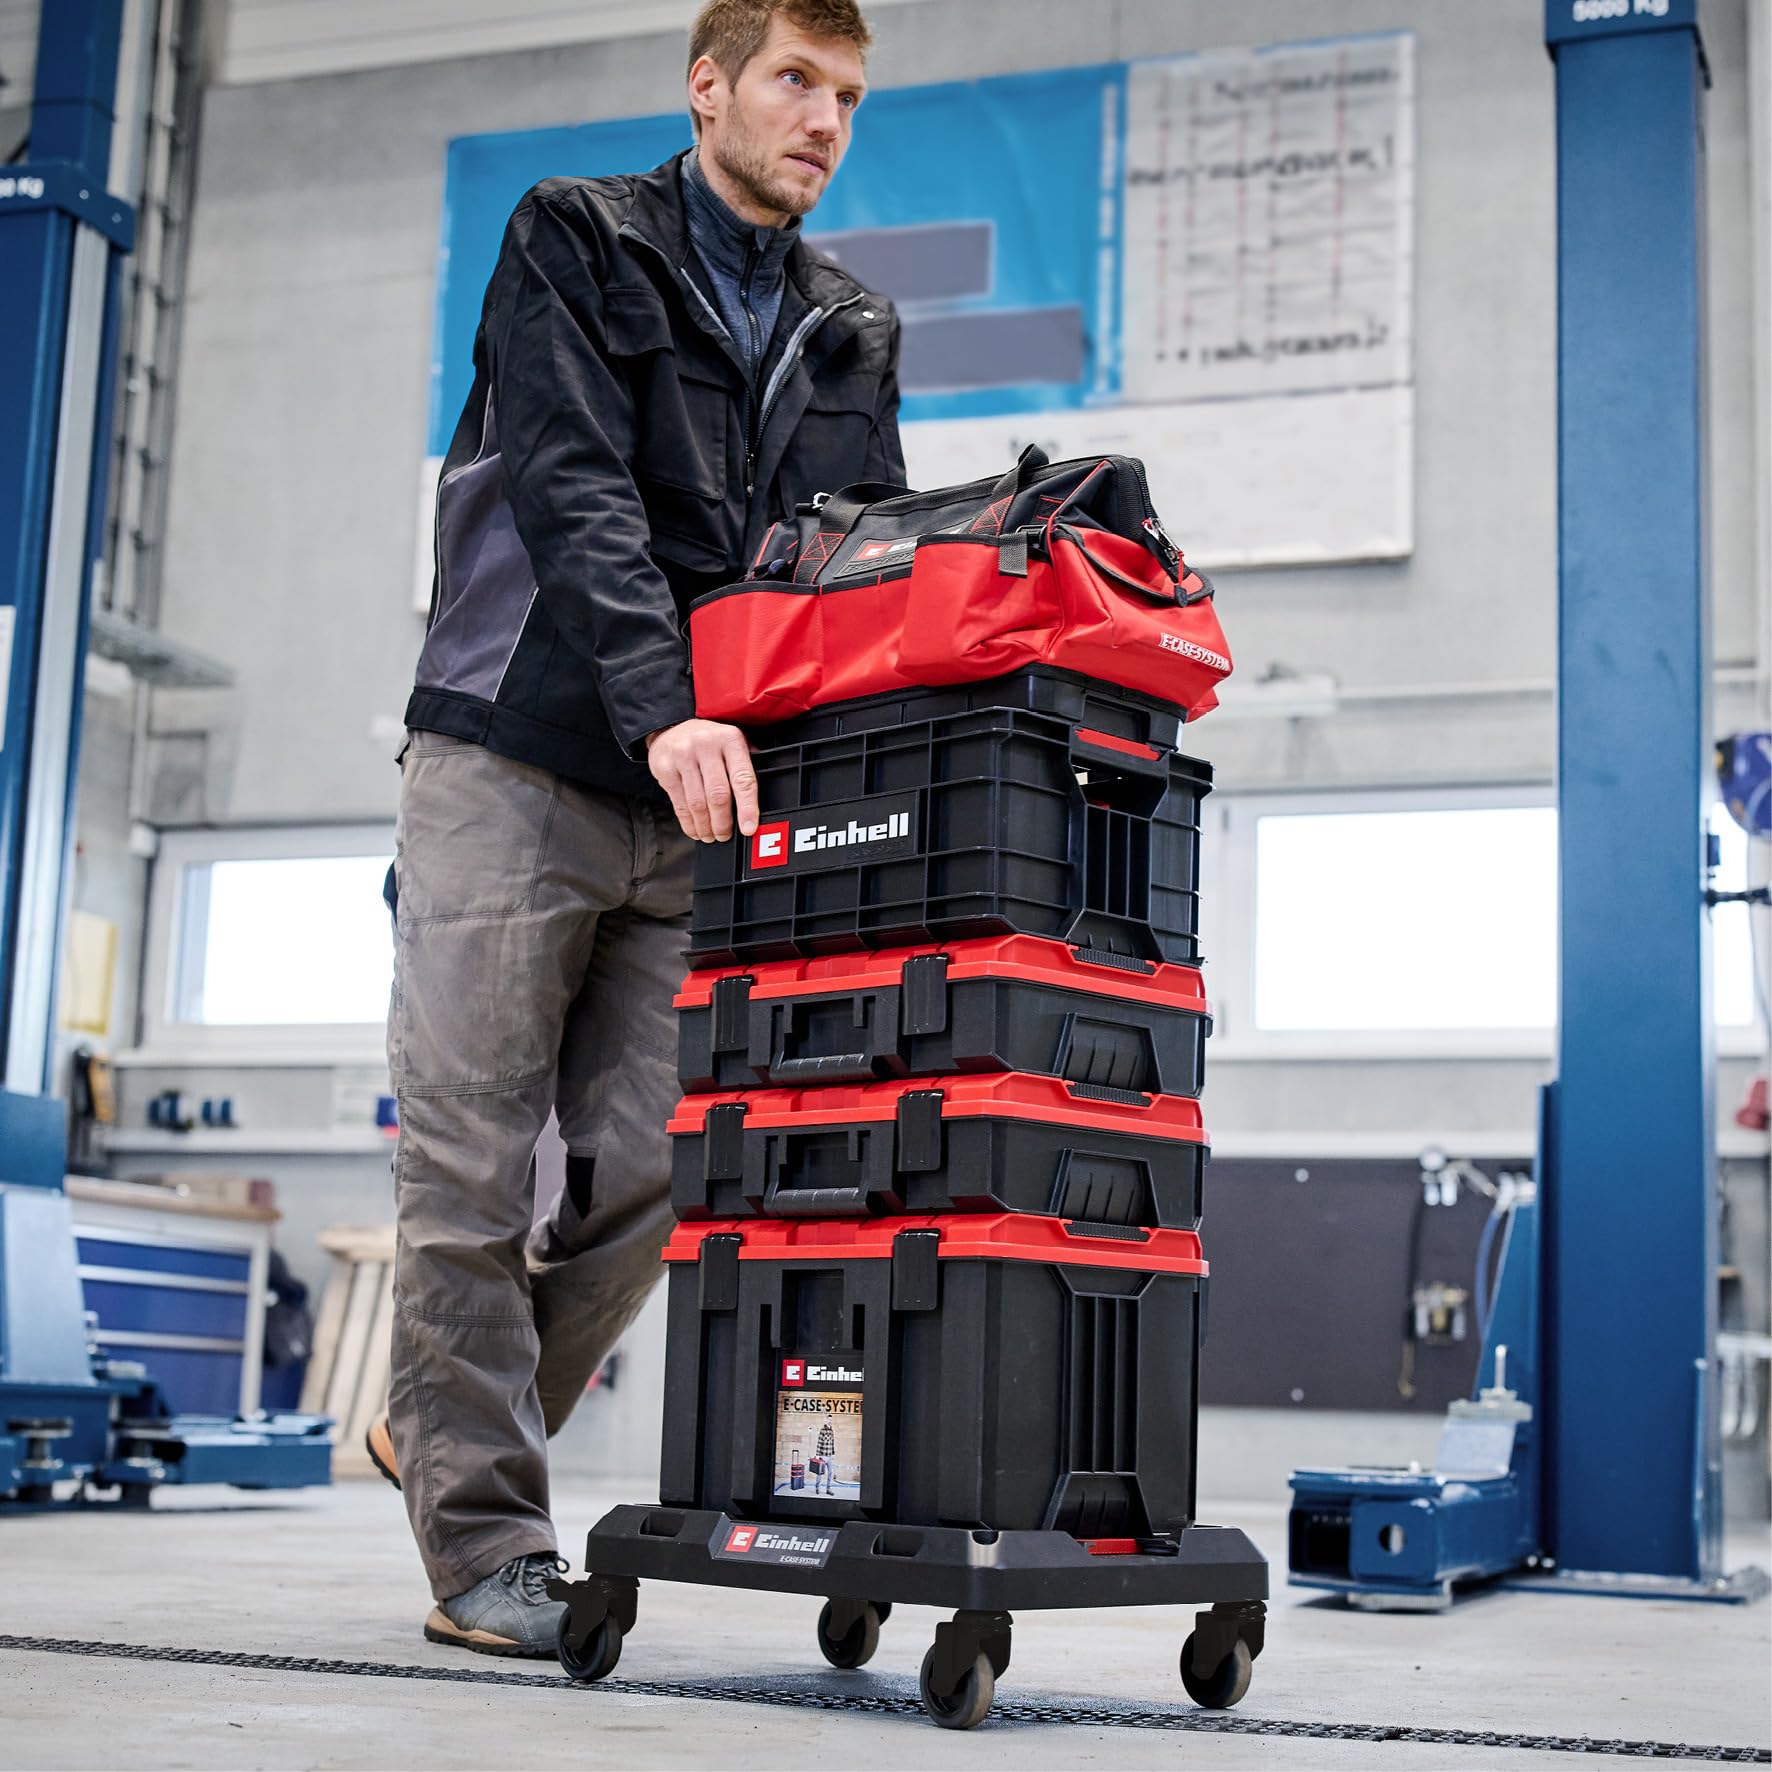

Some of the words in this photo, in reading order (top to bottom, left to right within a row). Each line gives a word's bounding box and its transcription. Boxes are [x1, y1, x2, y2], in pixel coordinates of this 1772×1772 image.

[795, 812, 909, 853] Einhell
[783, 1398, 863, 1413] E-CASE-SYSTE
[754, 1533, 829, 1553] Einhell
